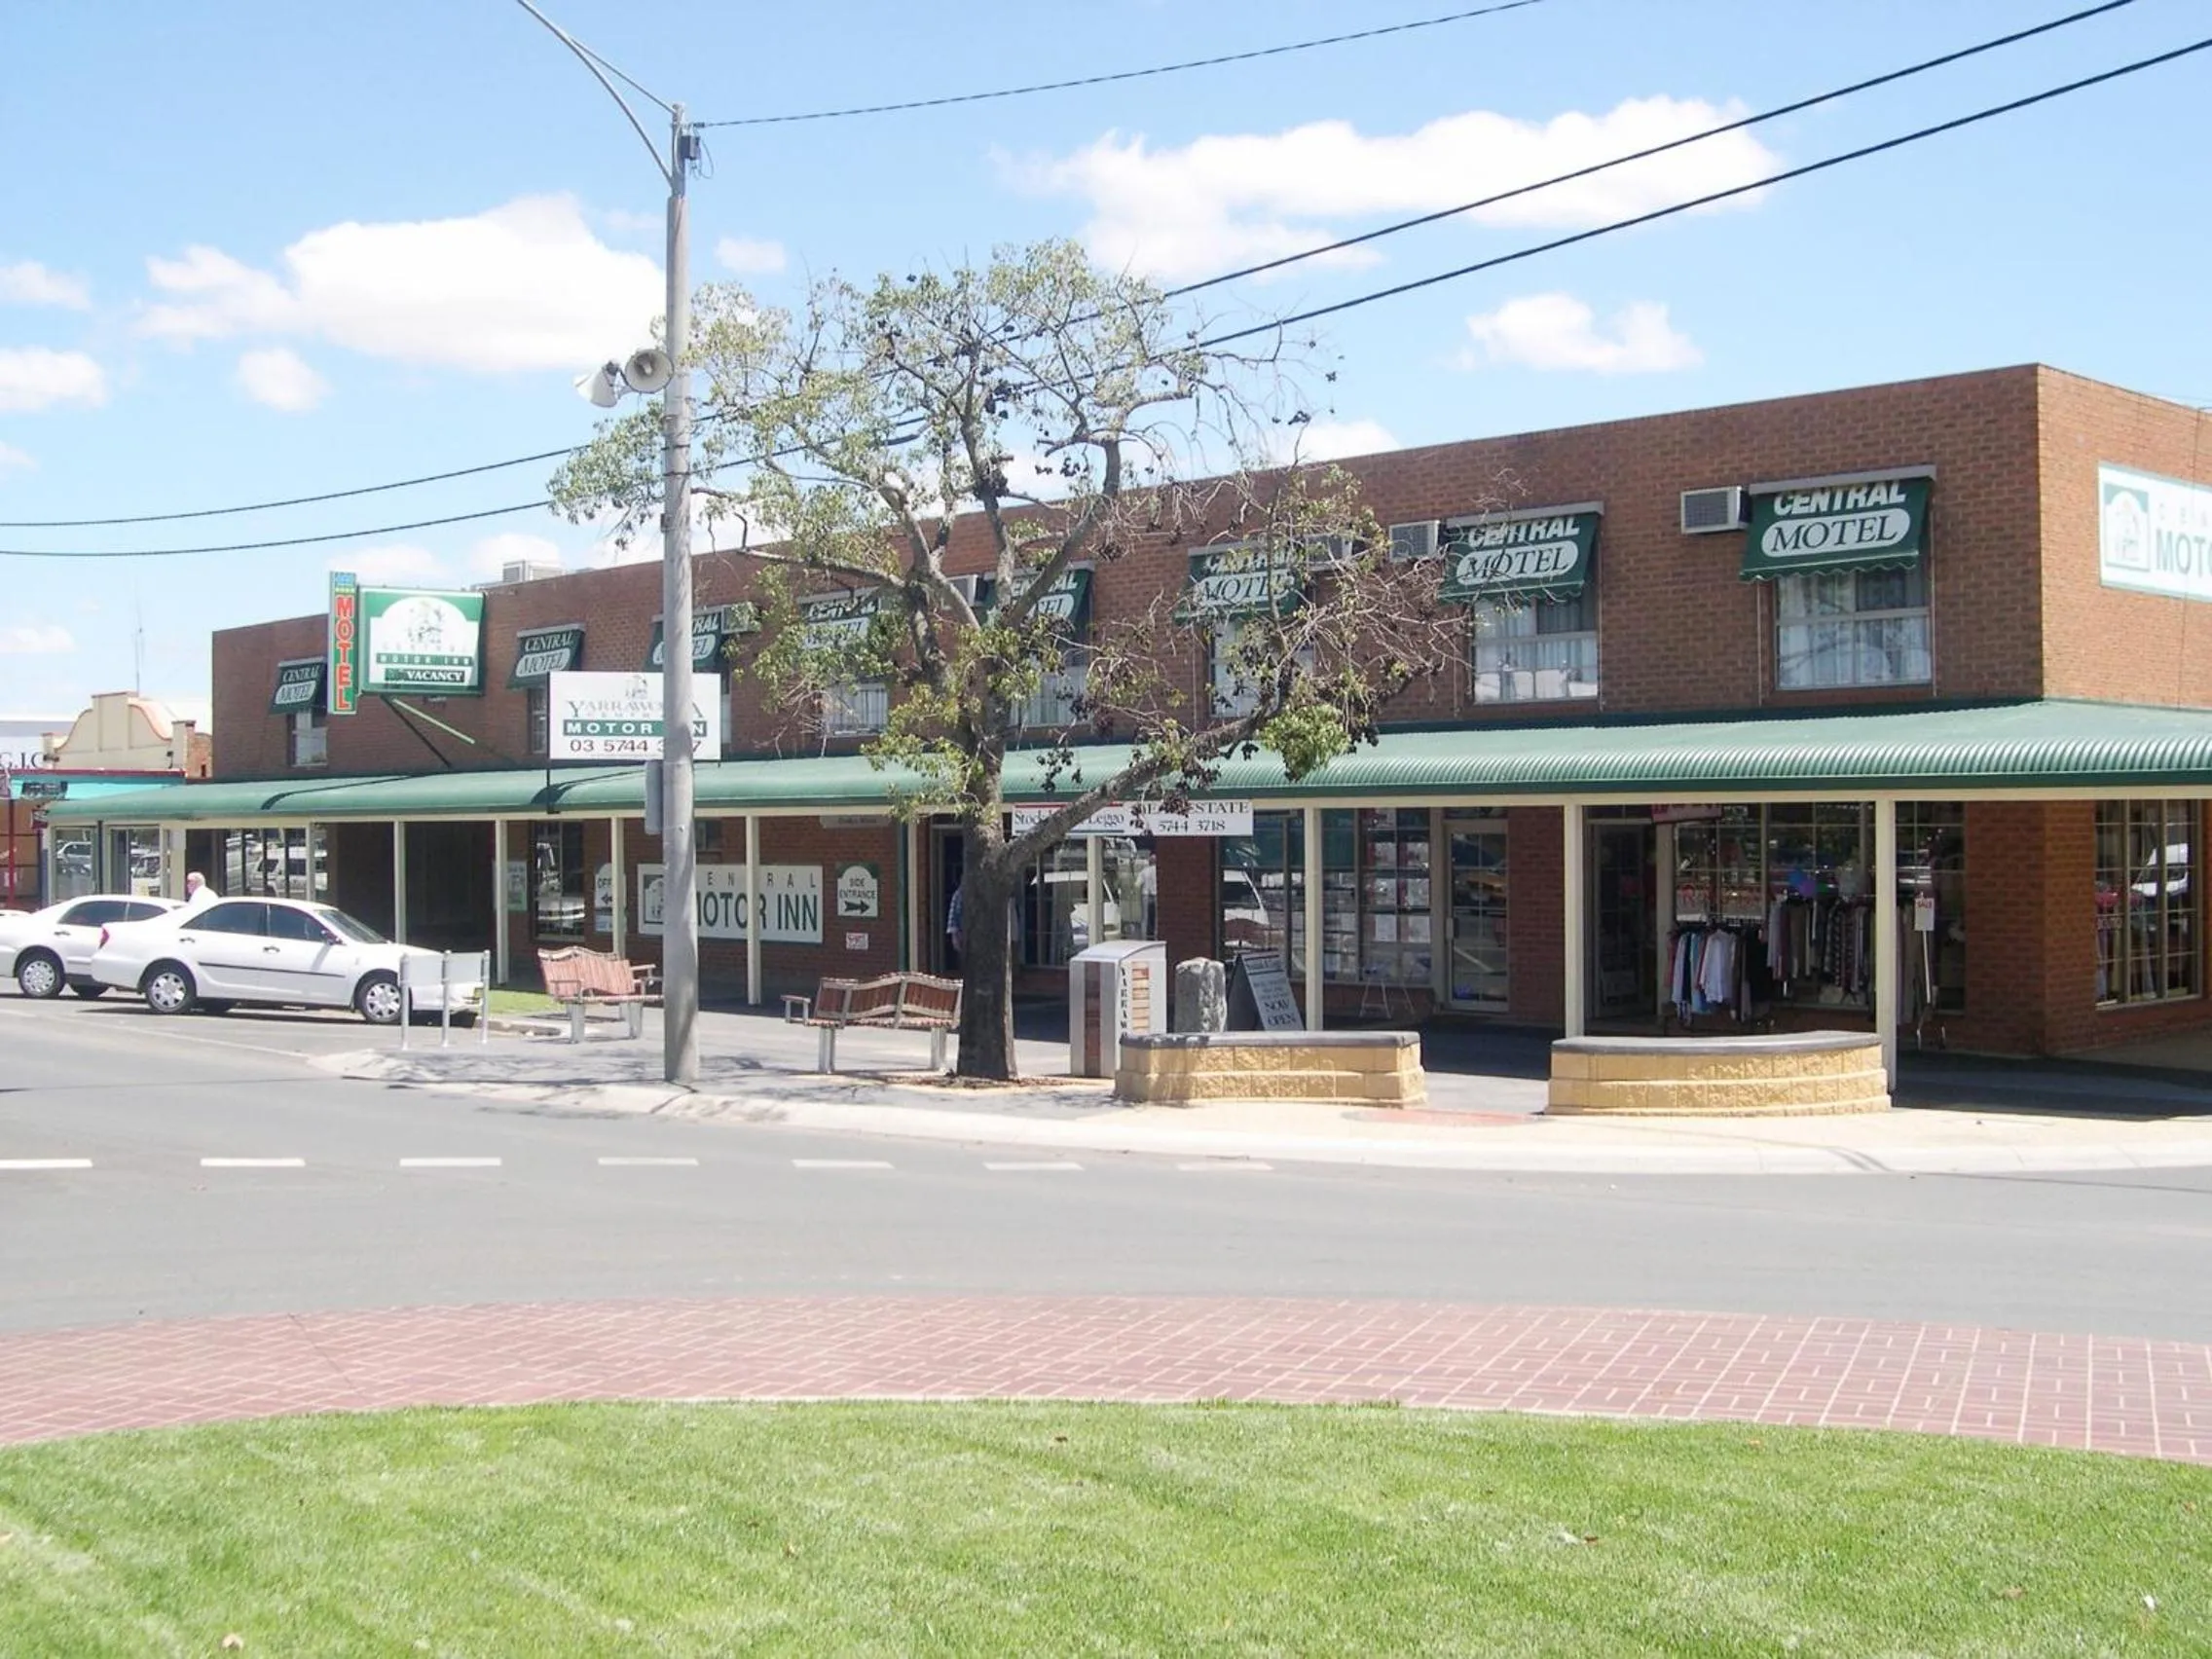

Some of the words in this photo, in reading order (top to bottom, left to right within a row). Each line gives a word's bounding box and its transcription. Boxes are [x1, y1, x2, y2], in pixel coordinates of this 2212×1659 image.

[1774, 482, 1908, 516] CENTRAL
[1468, 517, 1581, 548] CENTRAL
[1770, 515, 1898, 553] MOTEL
[1463, 546, 1569, 579] MOTEL
[524, 632, 574, 652] CENTRAL
[335, 595, 354, 711] MOTEL
[282, 665, 322, 682] CENTRAL
[407, 670, 462, 682] VACANCY
[566, 722, 653, 734] MOTOR
[570, 740, 594, 753] 03
[604, 739, 648, 753] 5744
[1088, 813, 1125, 827] Leggo
[707, 871, 816, 888] ENRAL
[849, 877, 866, 888] SIDE
[839, 889, 877, 900] ENTRANCE
[777, 894, 818, 932] INN
